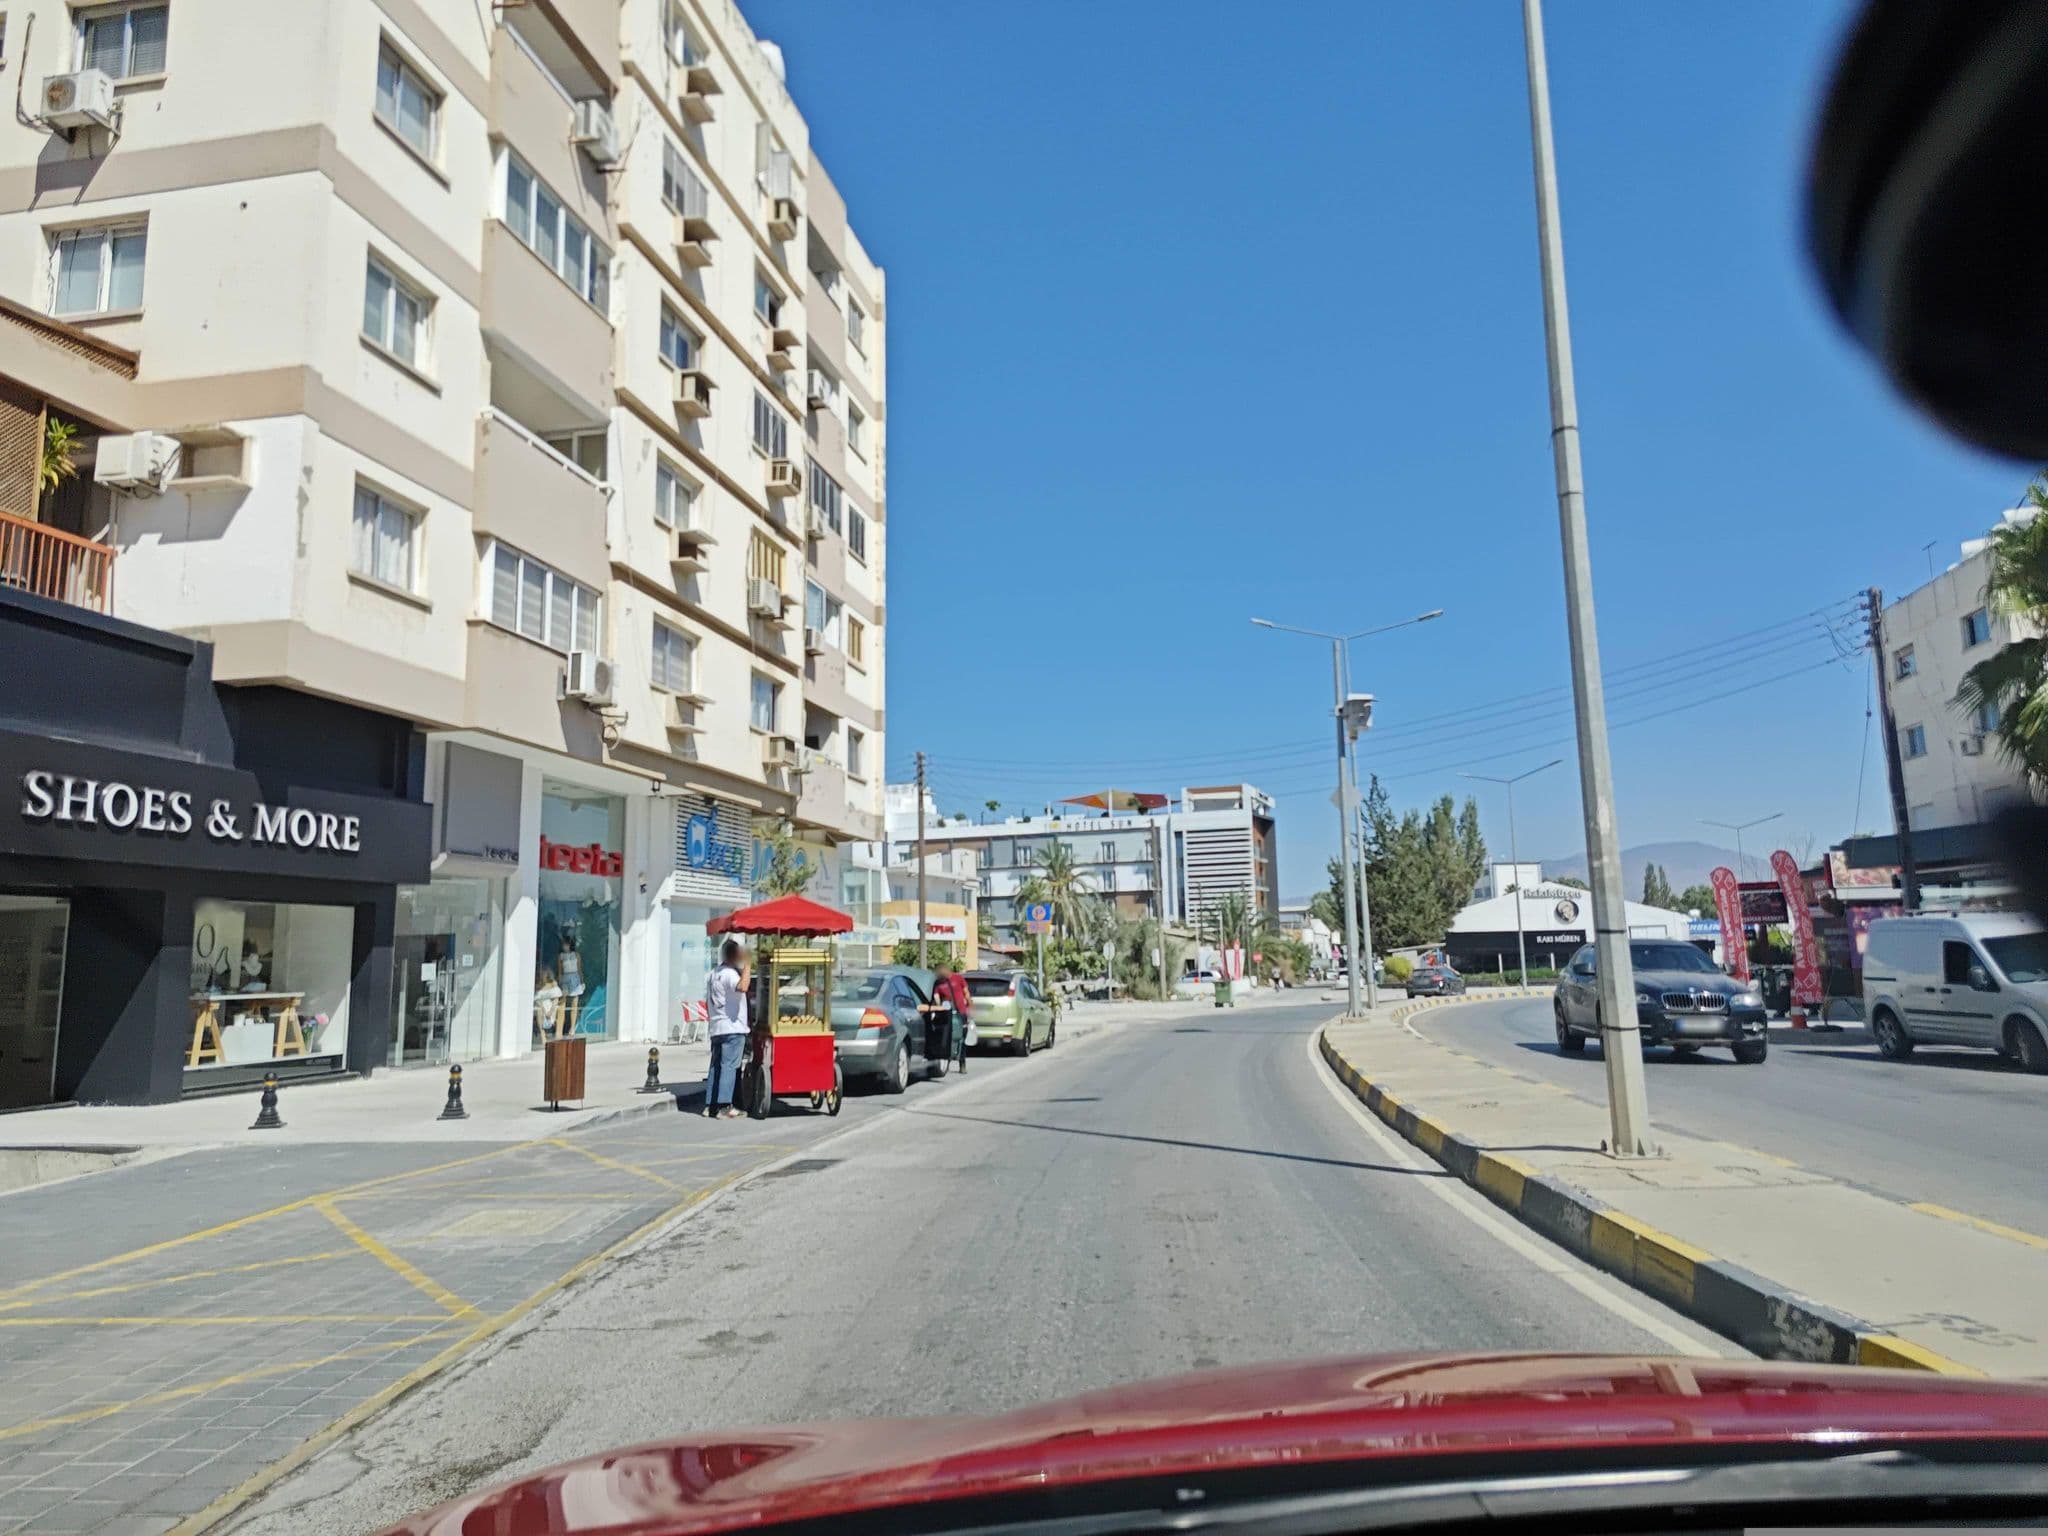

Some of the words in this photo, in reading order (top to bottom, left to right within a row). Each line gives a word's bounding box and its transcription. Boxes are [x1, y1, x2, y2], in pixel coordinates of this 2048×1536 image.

[22, 770, 192, 833] SHOES
[207, 798, 243, 841] &
[252, 802, 361, 852] MORE
[1067, 821, 1101, 831] HOTEL
[1111, 820, 1132, 829] SUN
